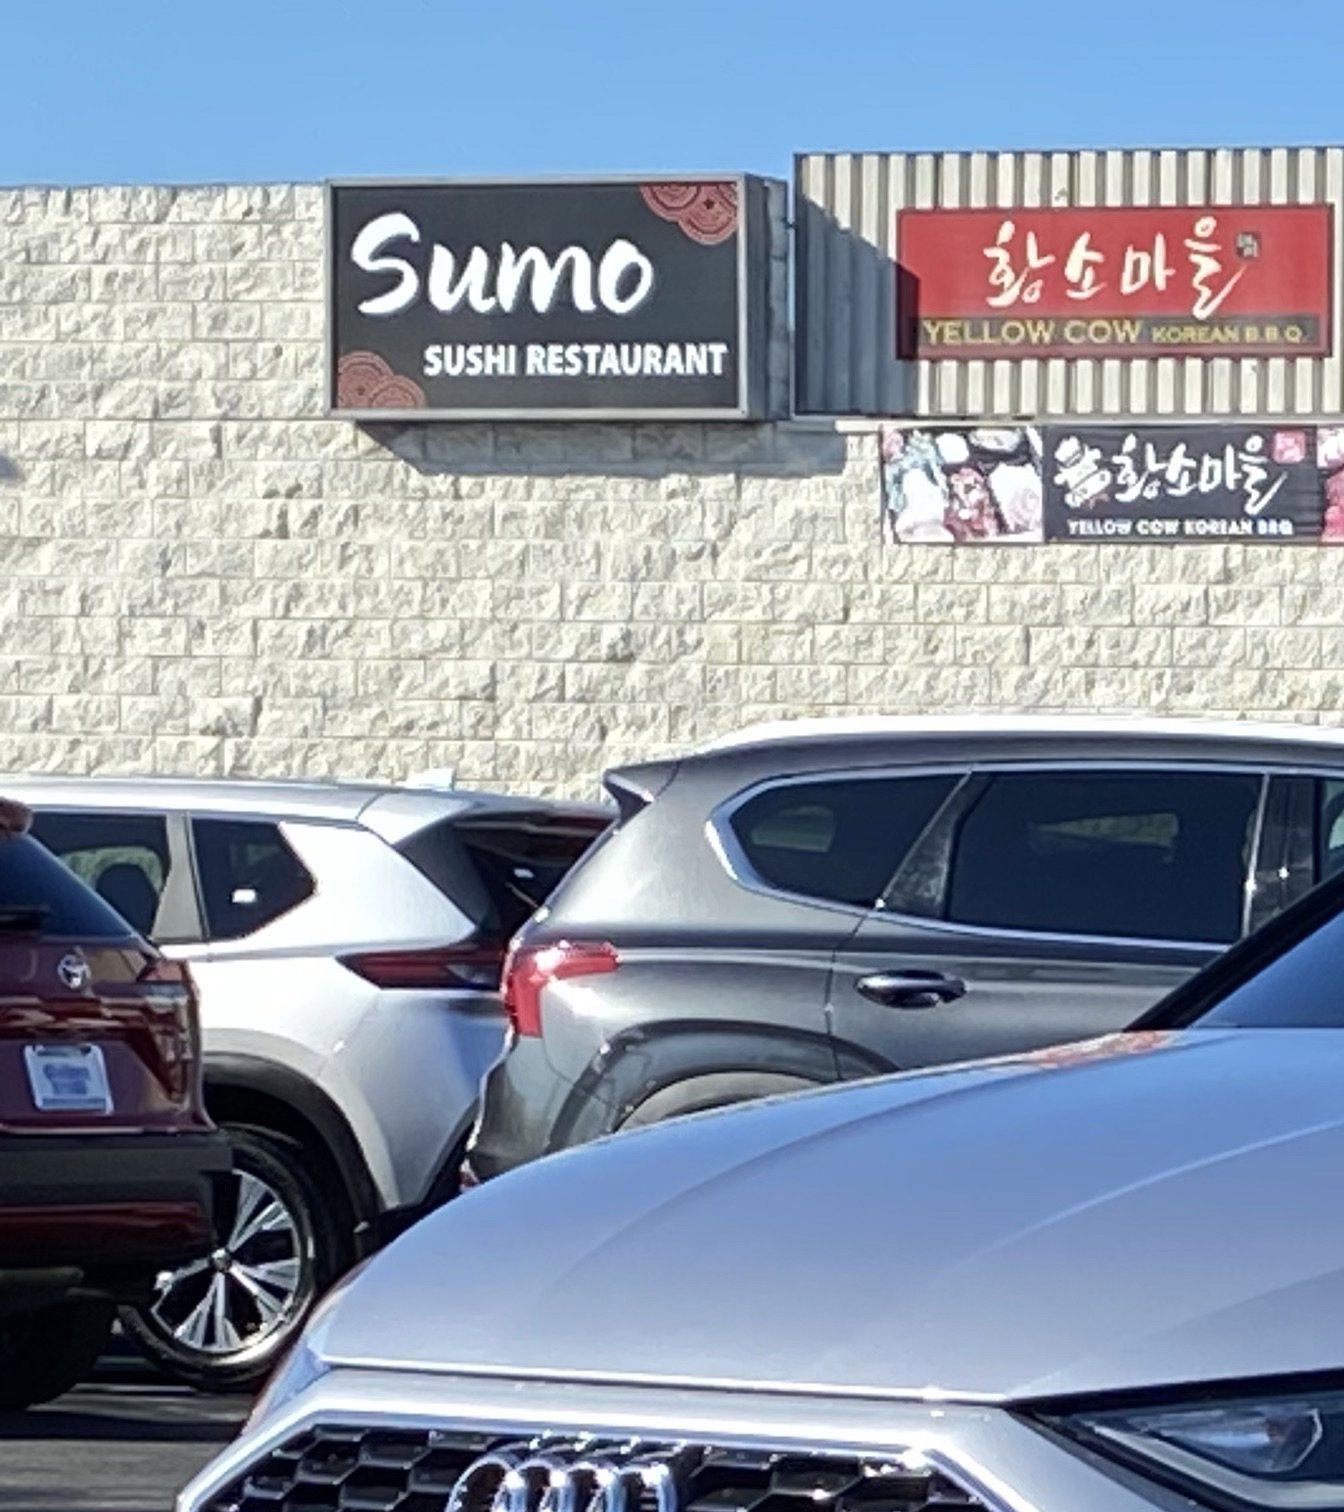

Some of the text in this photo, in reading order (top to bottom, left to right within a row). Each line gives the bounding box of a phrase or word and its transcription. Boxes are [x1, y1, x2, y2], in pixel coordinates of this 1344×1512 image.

[351, 212, 654, 315] Sumo
[983, 216, 1248, 320] 황소마을
[423, 342, 729, 376] SUSHI RESTAURANT
[922, 320, 1055, 345] YELLOW
[1063, 319, 1143, 345] COW
[1152, 325, 1240, 344] KOREAN
[1111, 433, 1288, 516] 황소마을
[1067, 519, 1294, 535] YELLOW COW KOREAN BBQ
